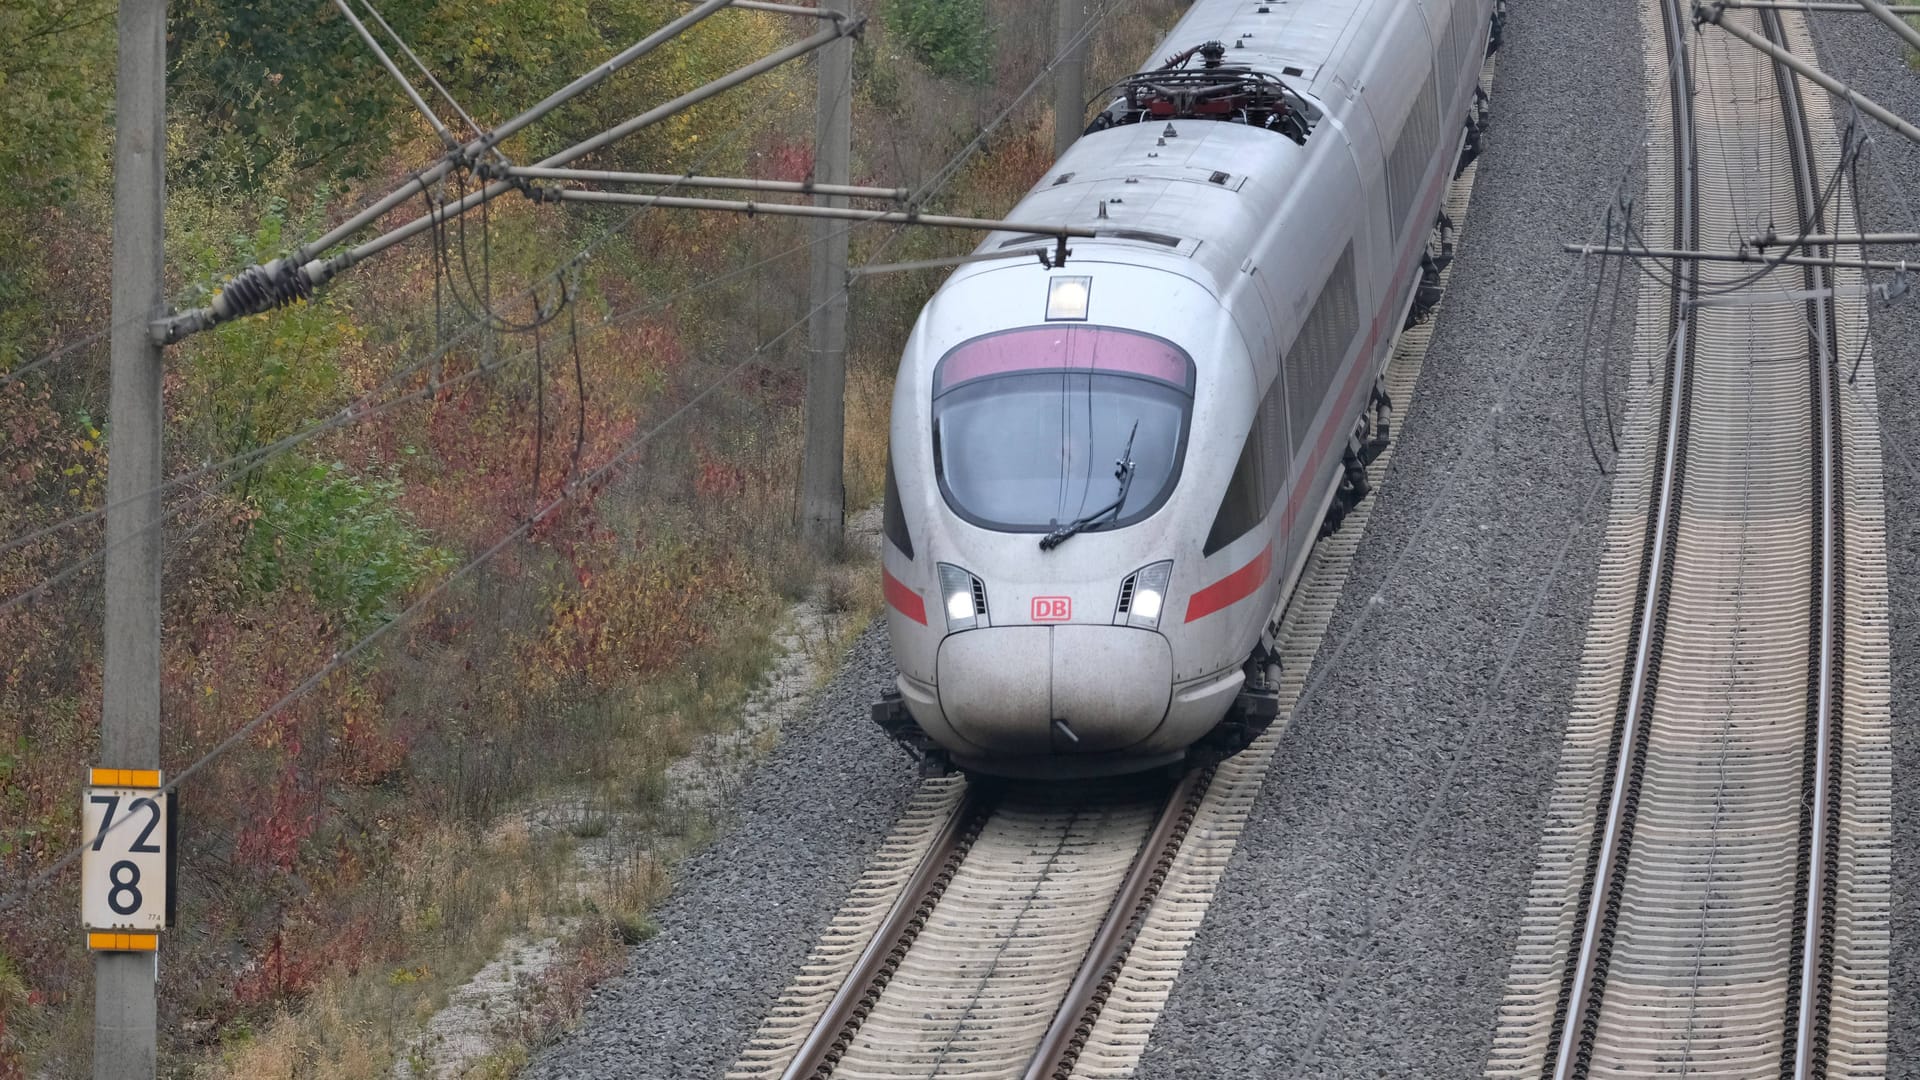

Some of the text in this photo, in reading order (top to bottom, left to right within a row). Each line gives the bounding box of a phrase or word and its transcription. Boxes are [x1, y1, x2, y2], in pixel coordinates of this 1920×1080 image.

[1036, 600, 1067, 617] DB
[90, 795, 161, 853] 72
[107, 859, 143, 915] 8
